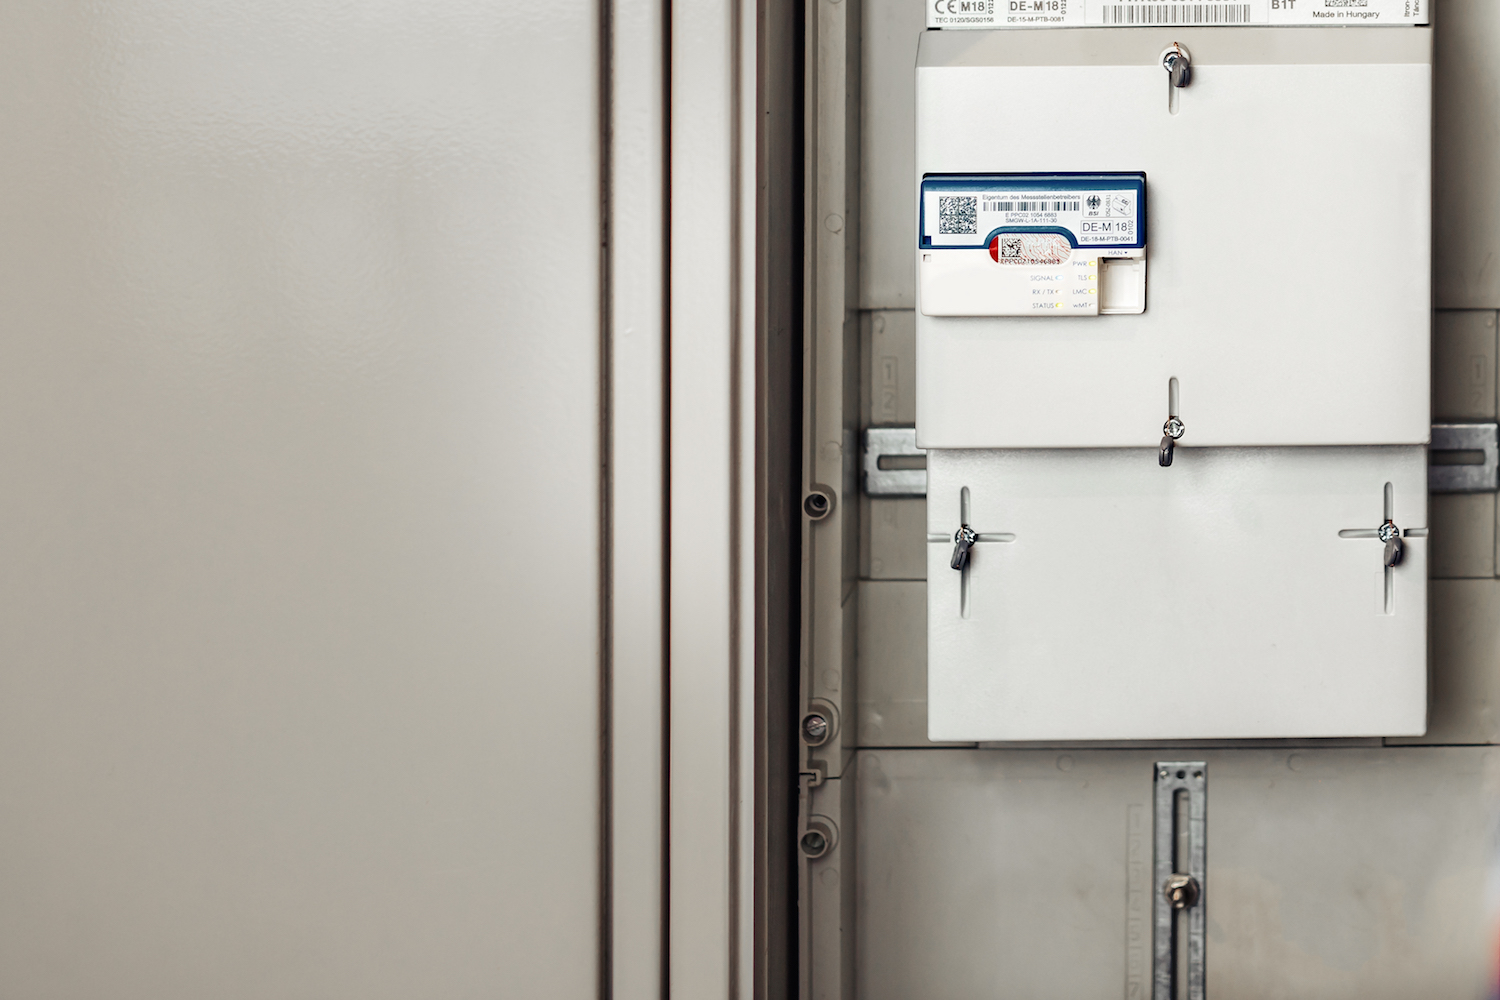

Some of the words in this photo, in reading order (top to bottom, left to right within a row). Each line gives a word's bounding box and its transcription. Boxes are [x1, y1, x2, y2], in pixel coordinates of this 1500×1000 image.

[961, 1, 985, 12] M18
[1010, 1, 1044, 11] DE-M
[1045, 1, 1059, 11] 18
[1271, 0, 1297, 10] B1T
[1346, 11, 1380, 19] Hungary
[1082, 222, 1112, 232] DE-M
[1115, 222, 1128, 232] 18
